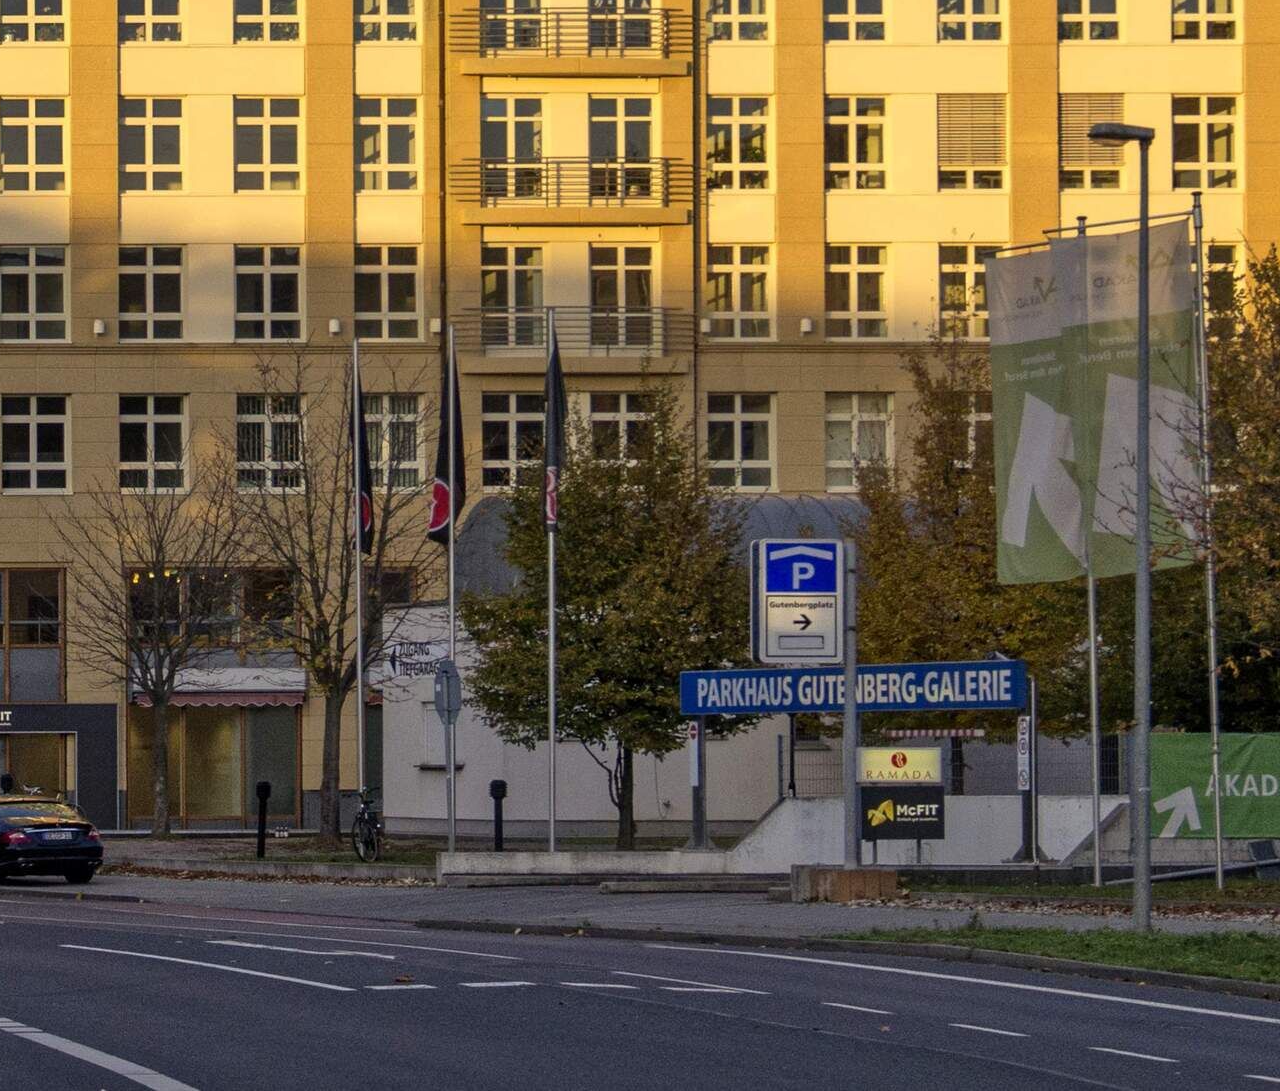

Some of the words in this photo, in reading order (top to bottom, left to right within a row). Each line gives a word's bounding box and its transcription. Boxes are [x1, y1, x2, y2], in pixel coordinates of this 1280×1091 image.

[792, 561, 816, 590] P
[769, 601, 834, 612] Gutenbergplatz
[399, 643, 430, 657] ZUGANG
[399, 660, 441, 676] TIEFGARAG
[697, 674, 793, 708] PARKHAUS
[866, 769, 933, 780] RAMADA
[1204, 773, 1279, 797] AKAD
[896, 804, 939, 816] McFIT
